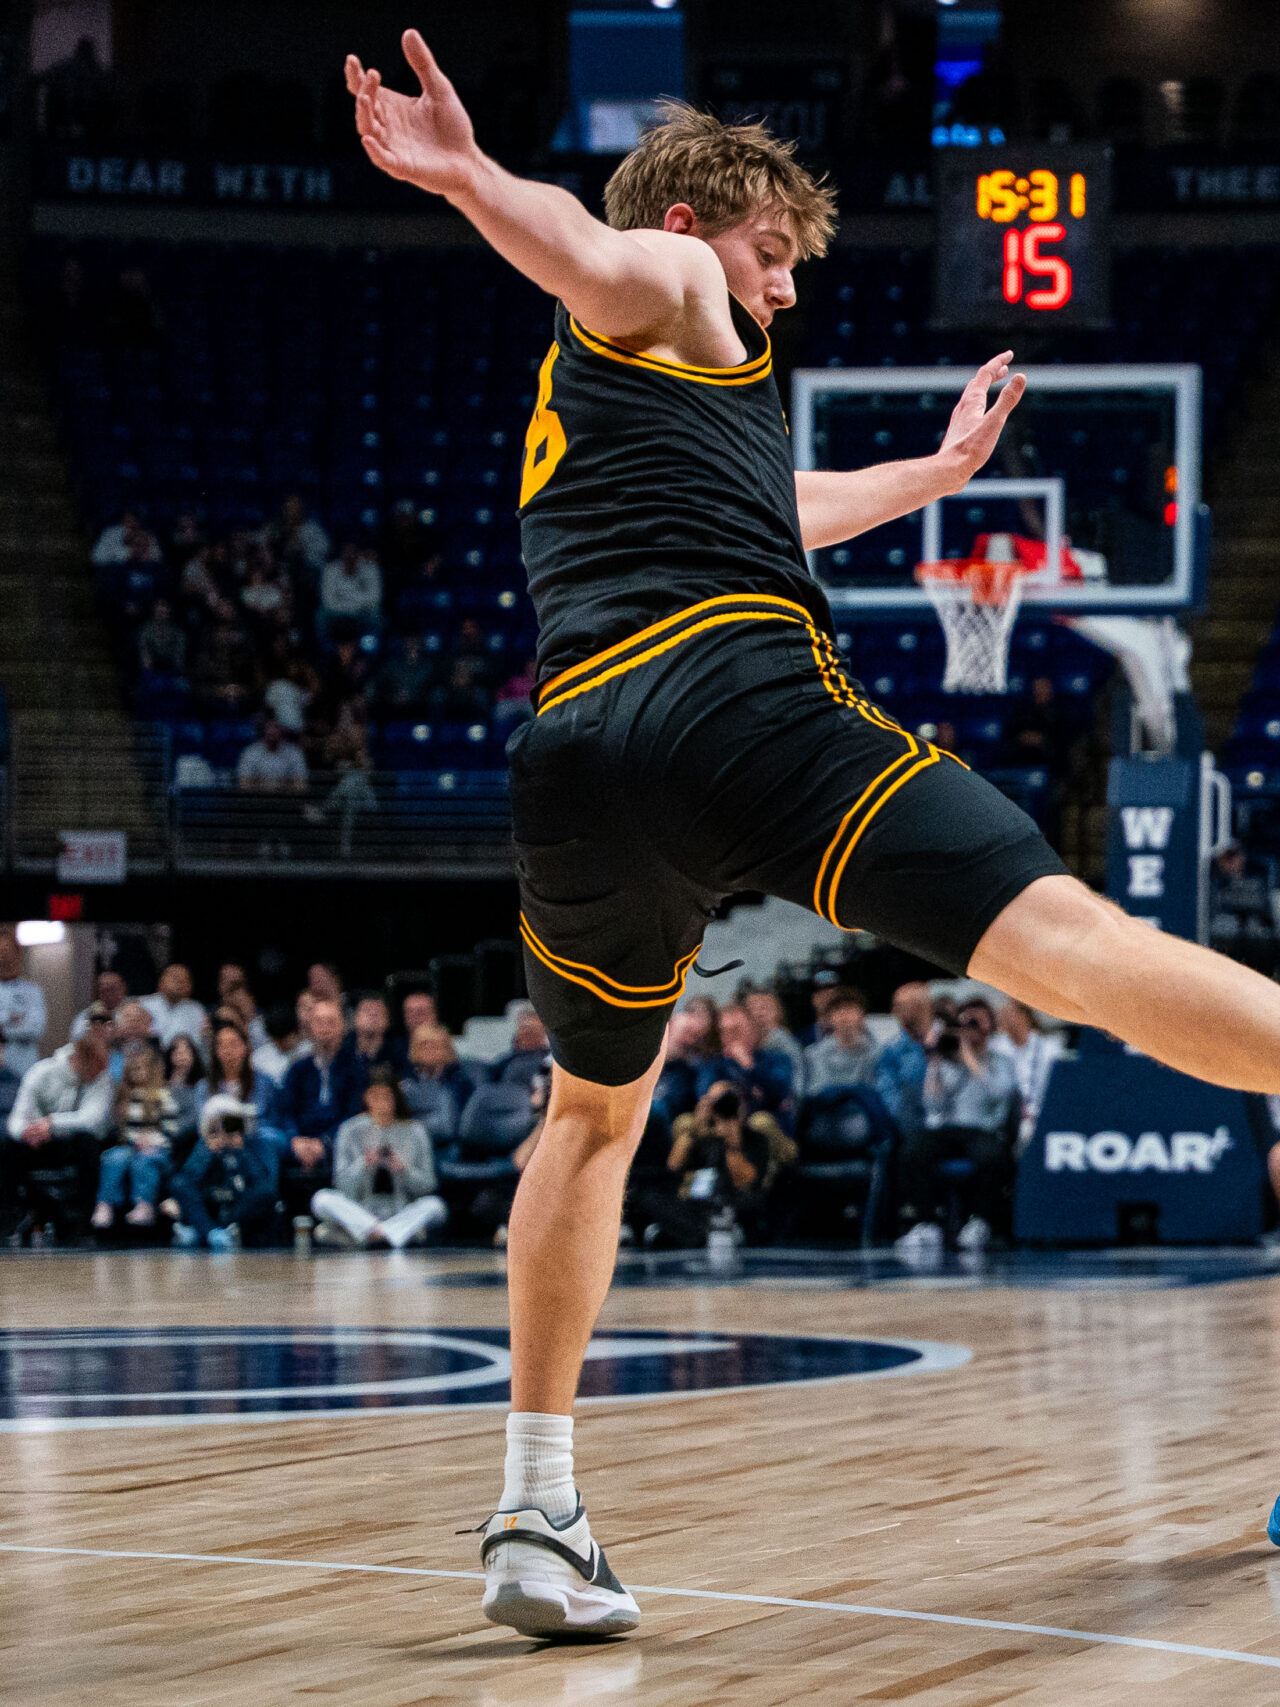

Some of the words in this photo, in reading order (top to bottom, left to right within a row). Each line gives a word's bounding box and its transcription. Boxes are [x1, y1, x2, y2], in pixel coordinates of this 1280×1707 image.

[67, 156, 187, 194] DEAR
[213, 163, 333, 199] WITH
[885, 171, 934, 203] AL
[977, 170, 1086, 222] 15:31
[1003, 223, 1072, 310] 15
[1121, 806, 1174, 897] WE
[1044, 1130, 1216, 1174] ROAR
[504, 1515, 519, 1530] 12
